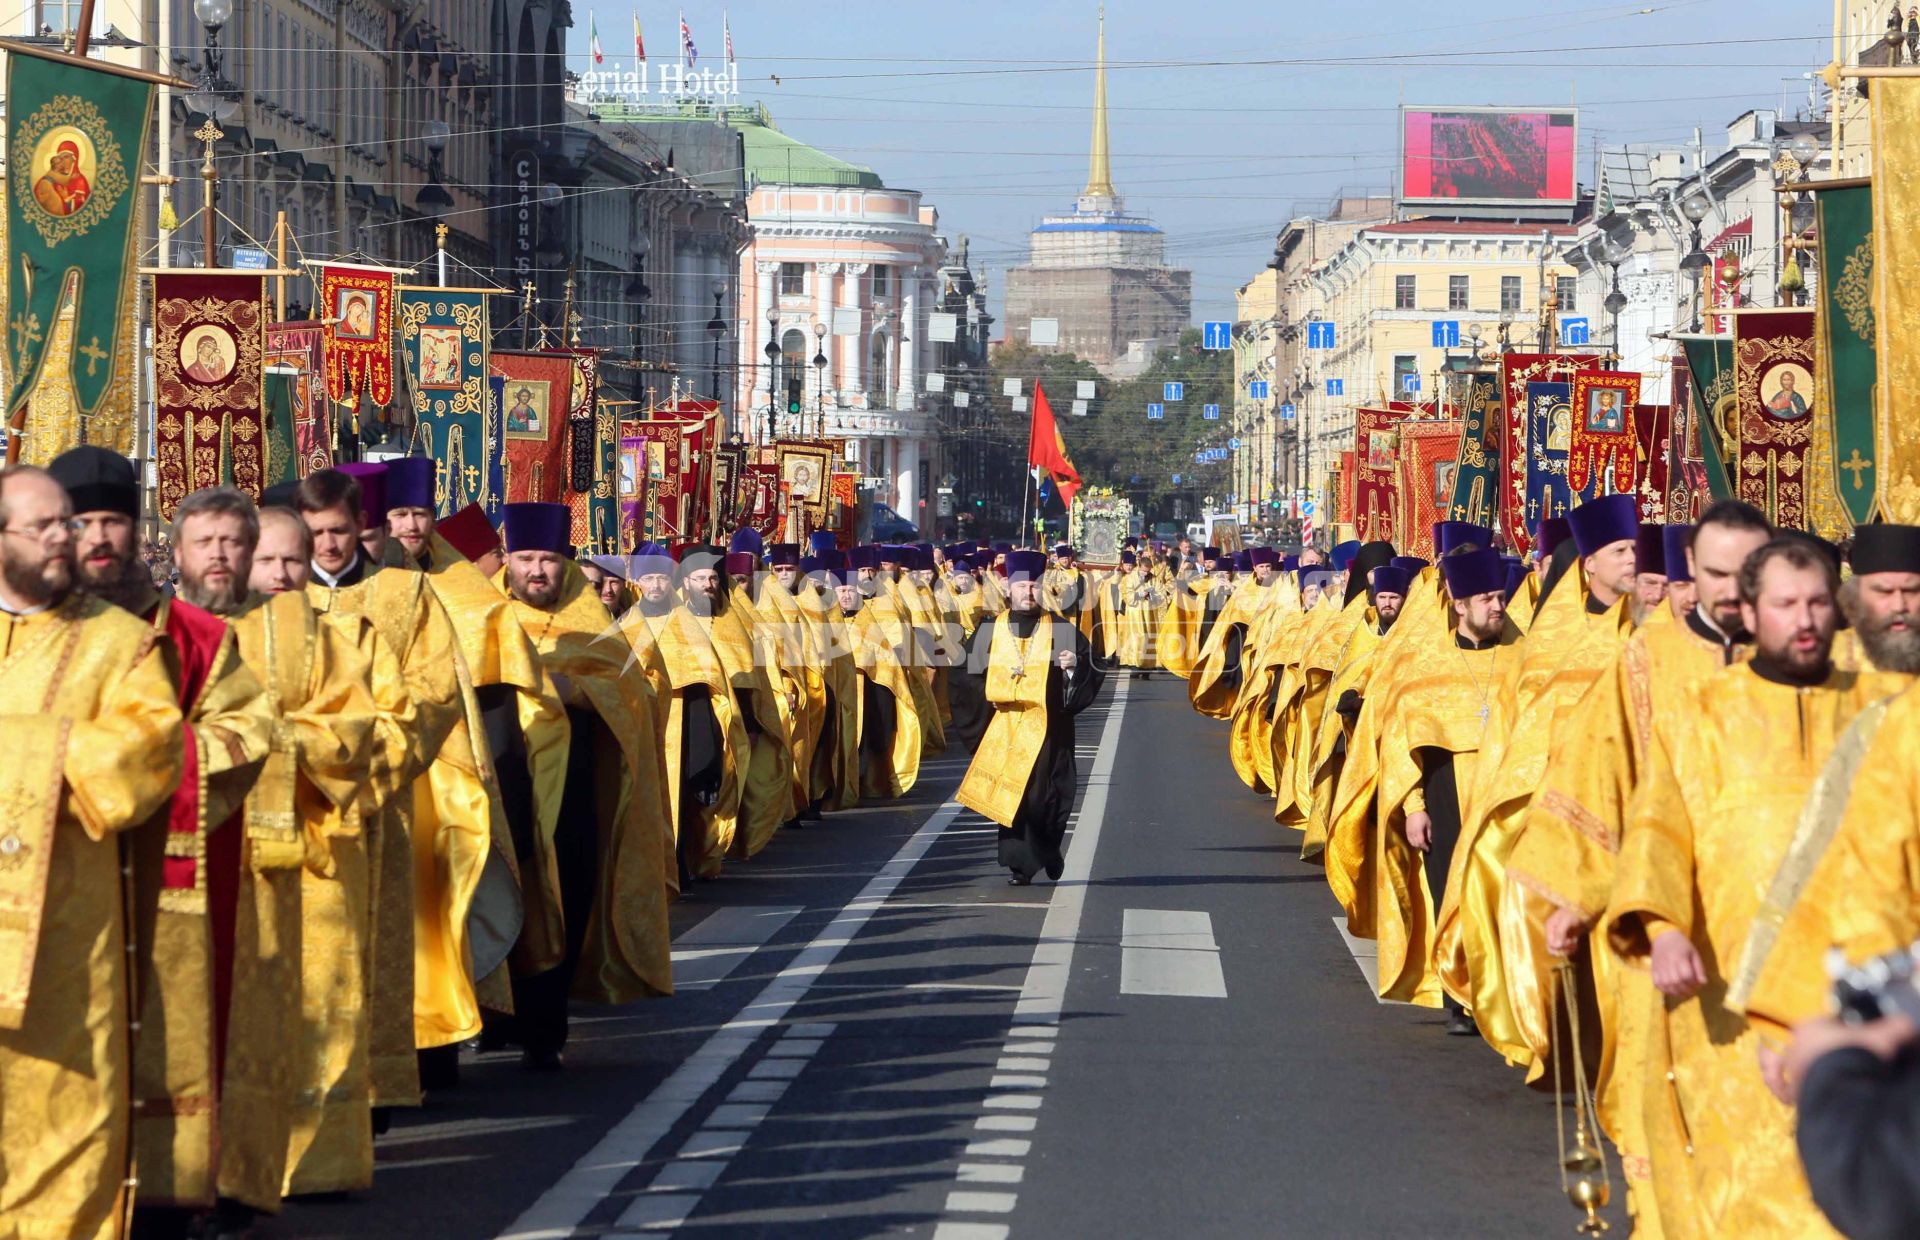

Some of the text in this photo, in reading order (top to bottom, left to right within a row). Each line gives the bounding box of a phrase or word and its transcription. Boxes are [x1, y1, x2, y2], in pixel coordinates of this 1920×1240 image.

[578, 63, 739, 94] erial Hotel
[516, 160, 530, 250] Салонъ
